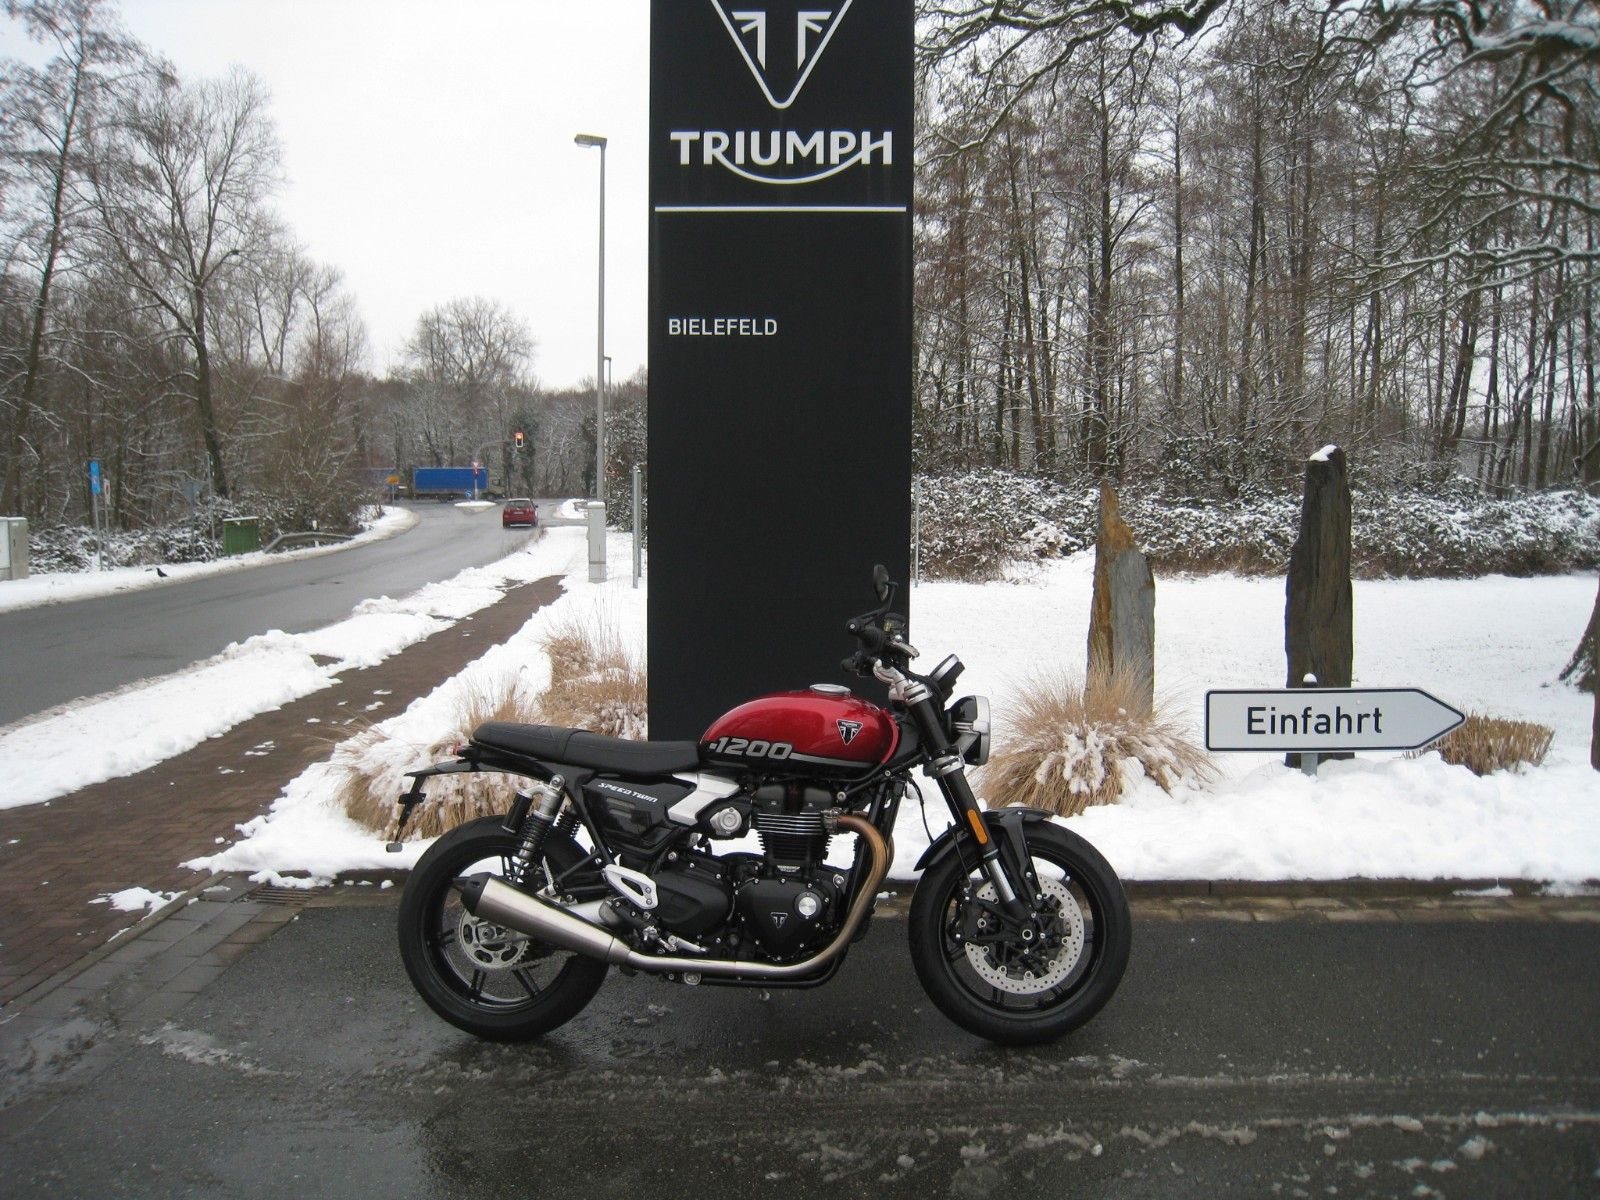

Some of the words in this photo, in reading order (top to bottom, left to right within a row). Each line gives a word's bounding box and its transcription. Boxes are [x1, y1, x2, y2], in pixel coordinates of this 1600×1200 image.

[670, 131, 893, 184] TRIUMPH
[668, 318, 778, 336] BIELEFELD
[1247, 706, 1383, 735] Einfahrt
[598, 782, 632, 795] SPEED
